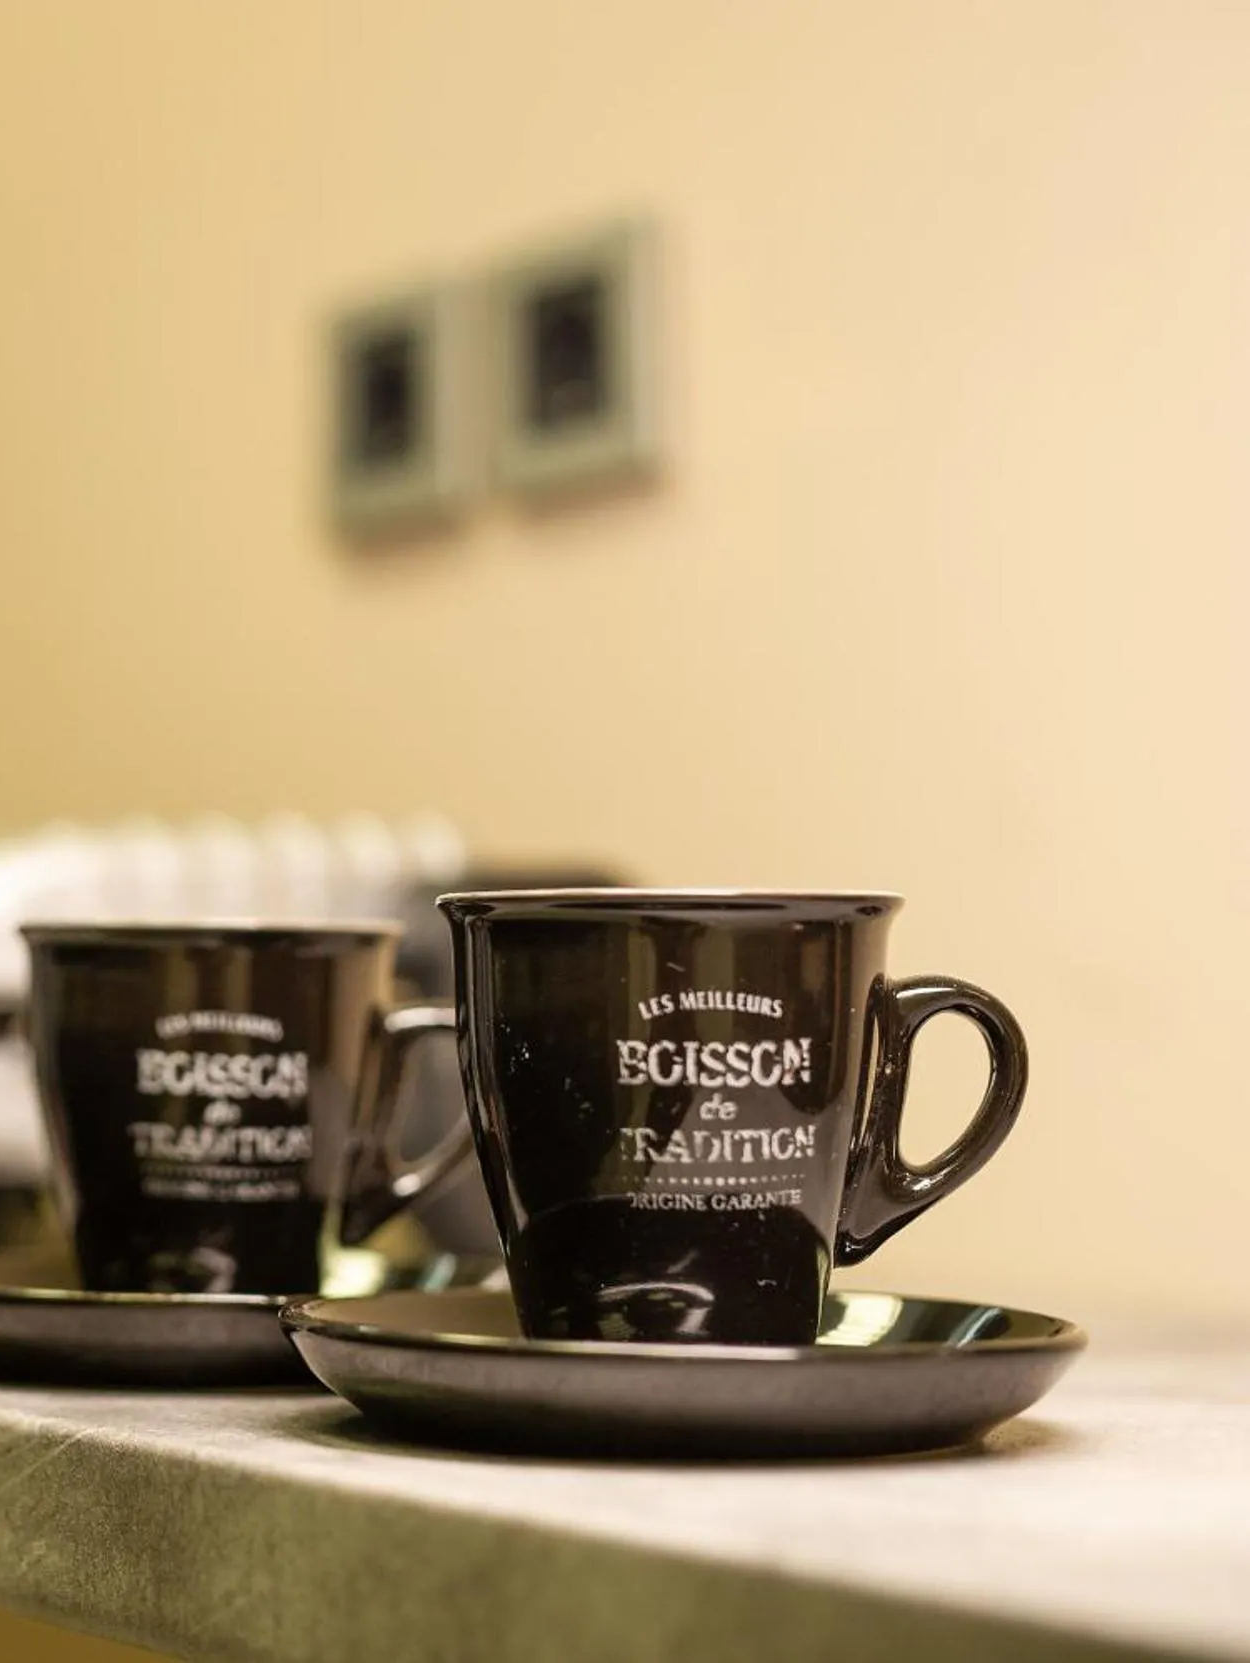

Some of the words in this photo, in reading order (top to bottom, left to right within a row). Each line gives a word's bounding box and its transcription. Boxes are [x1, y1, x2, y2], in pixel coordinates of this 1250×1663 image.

[638, 993, 675, 1021] LES
[679, 990, 784, 1018] MEILLEURS
[616, 1038, 812, 1088] BOISSON
[699, 1093, 738, 1121] de
[620, 1124, 817, 1164] TRADITION
